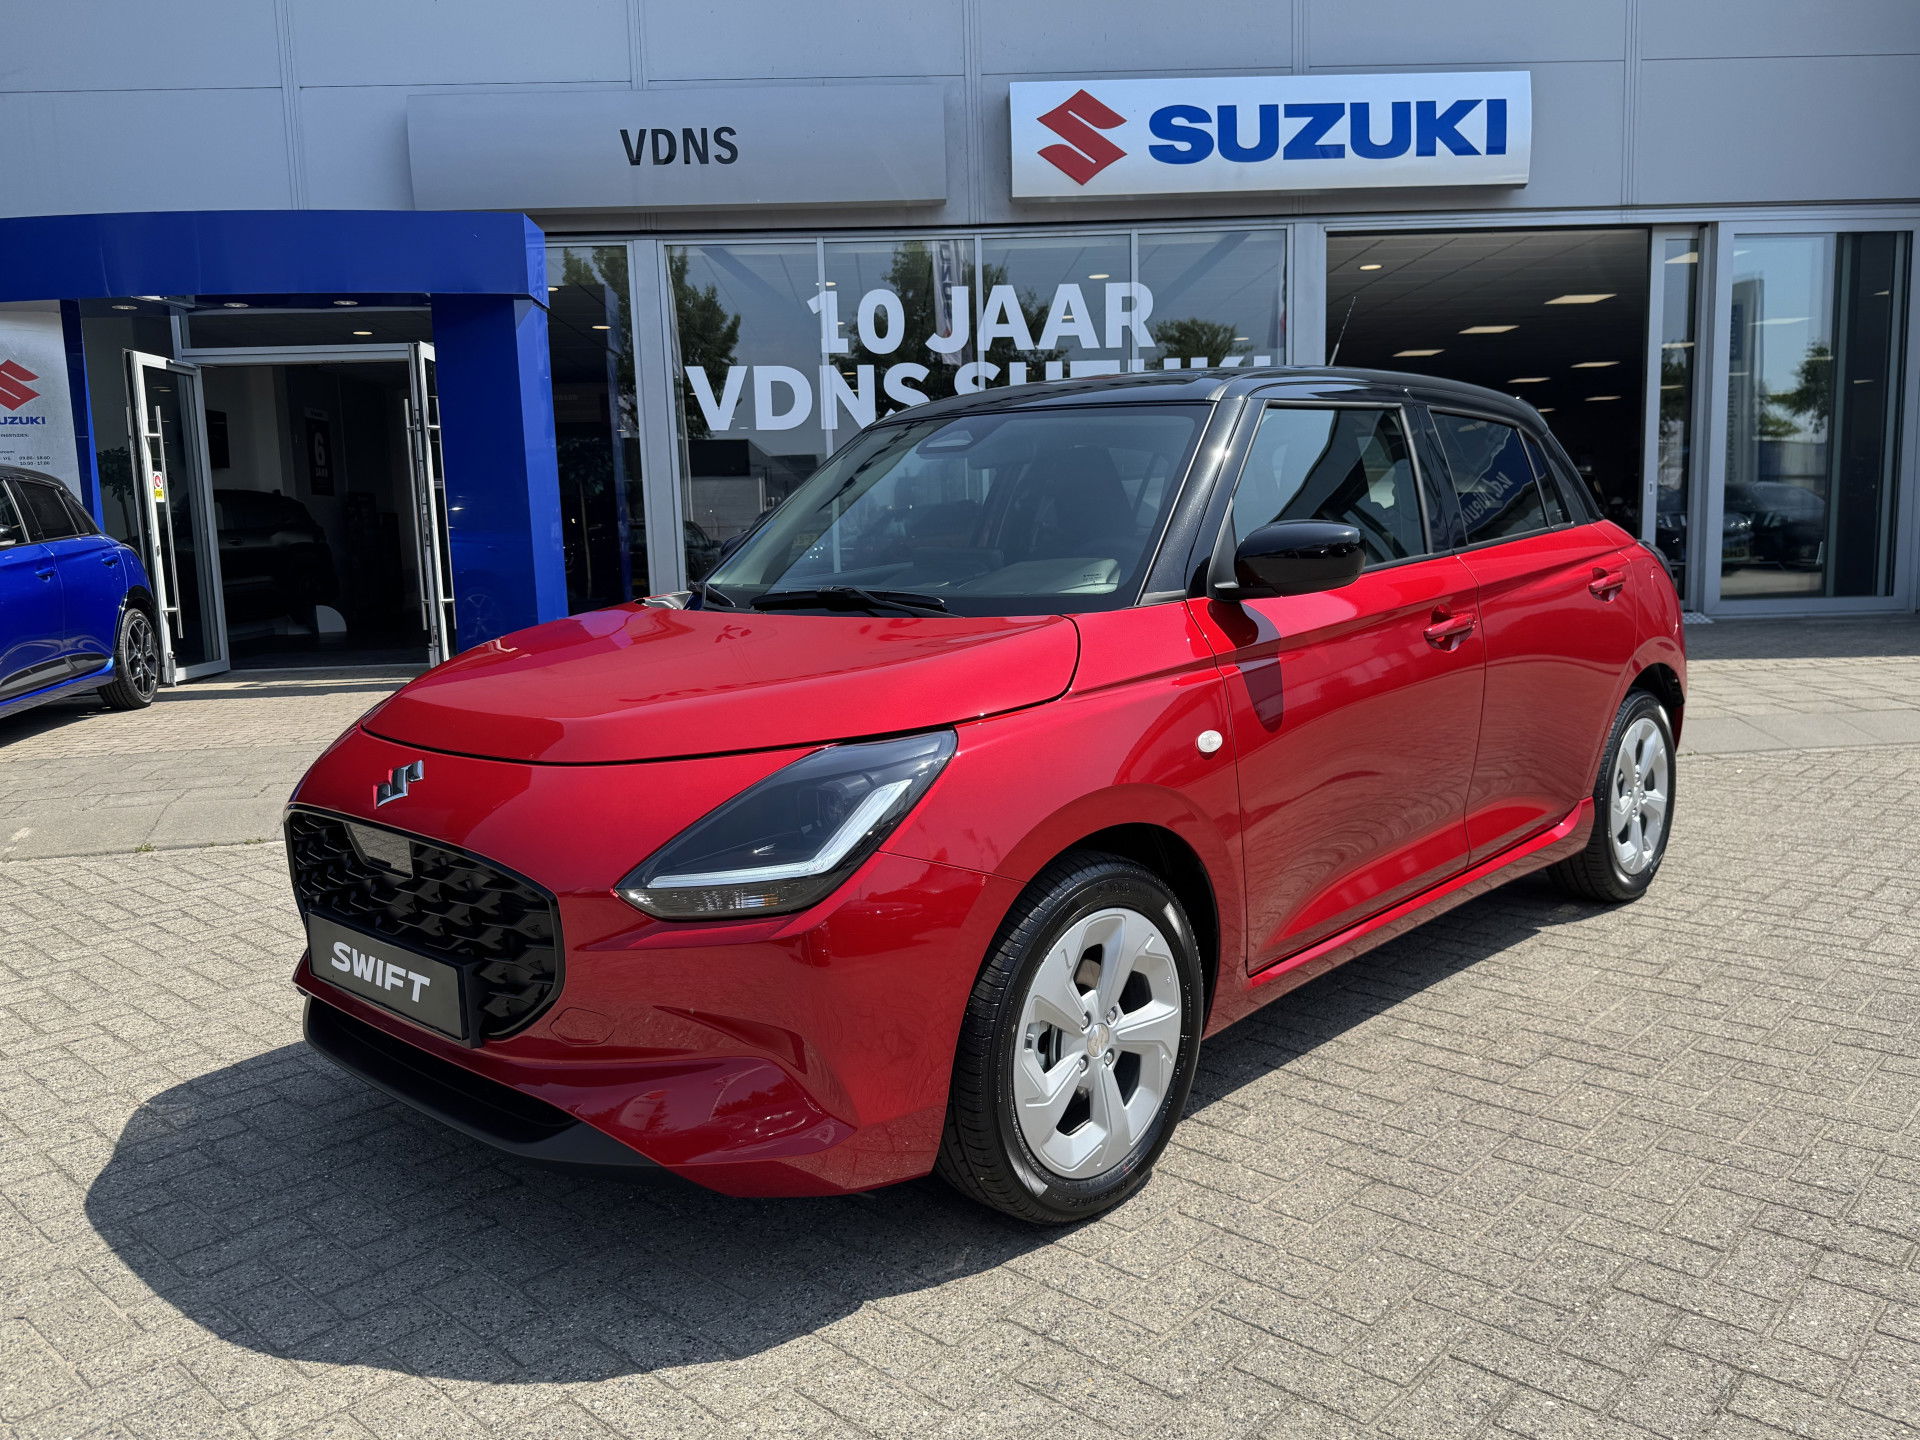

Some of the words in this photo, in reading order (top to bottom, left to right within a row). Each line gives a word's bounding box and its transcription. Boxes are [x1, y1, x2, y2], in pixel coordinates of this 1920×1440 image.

[619, 126, 739, 166] VDNS
[1148, 98, 1507, 165] SUZUKI
[806, 288, 905, 354] 10
[925, 282, 1156, 352] JAAR
[0, 416, 46, 425] UZUKI
[331, 941, 430, 1003] SWIFT
